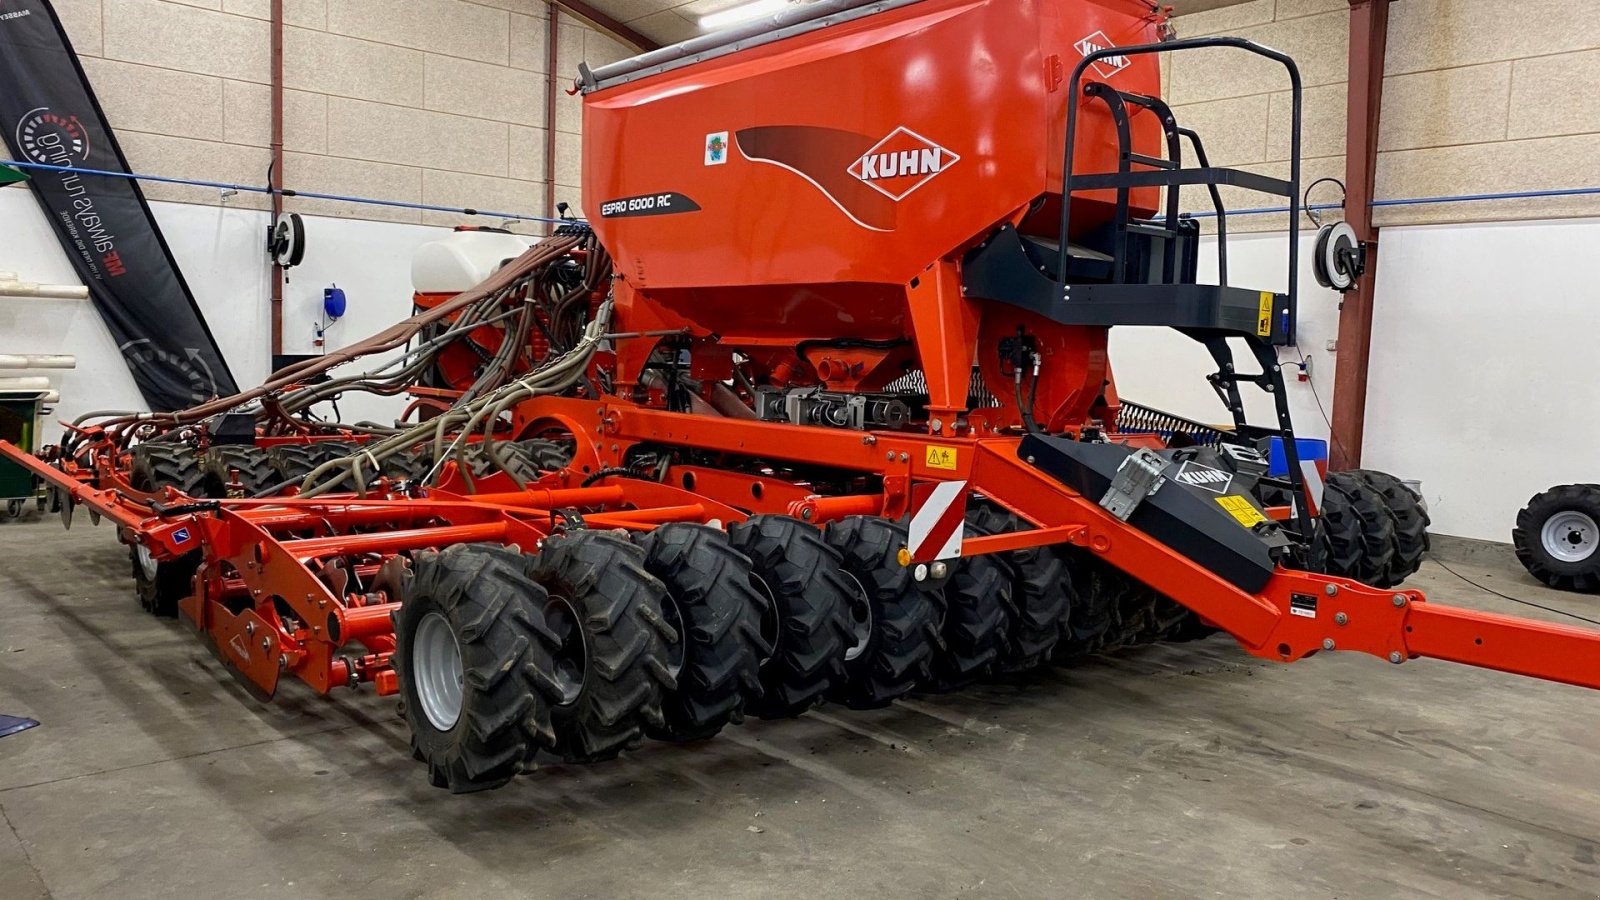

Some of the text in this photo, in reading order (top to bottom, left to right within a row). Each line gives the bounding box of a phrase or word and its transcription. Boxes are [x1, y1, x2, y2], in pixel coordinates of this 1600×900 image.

[861, 147, 941, 180] KUHN
[601, 194, 671, 216] ESPRO 6000 RC
[1180, 469, 1230, 485] KUHN
